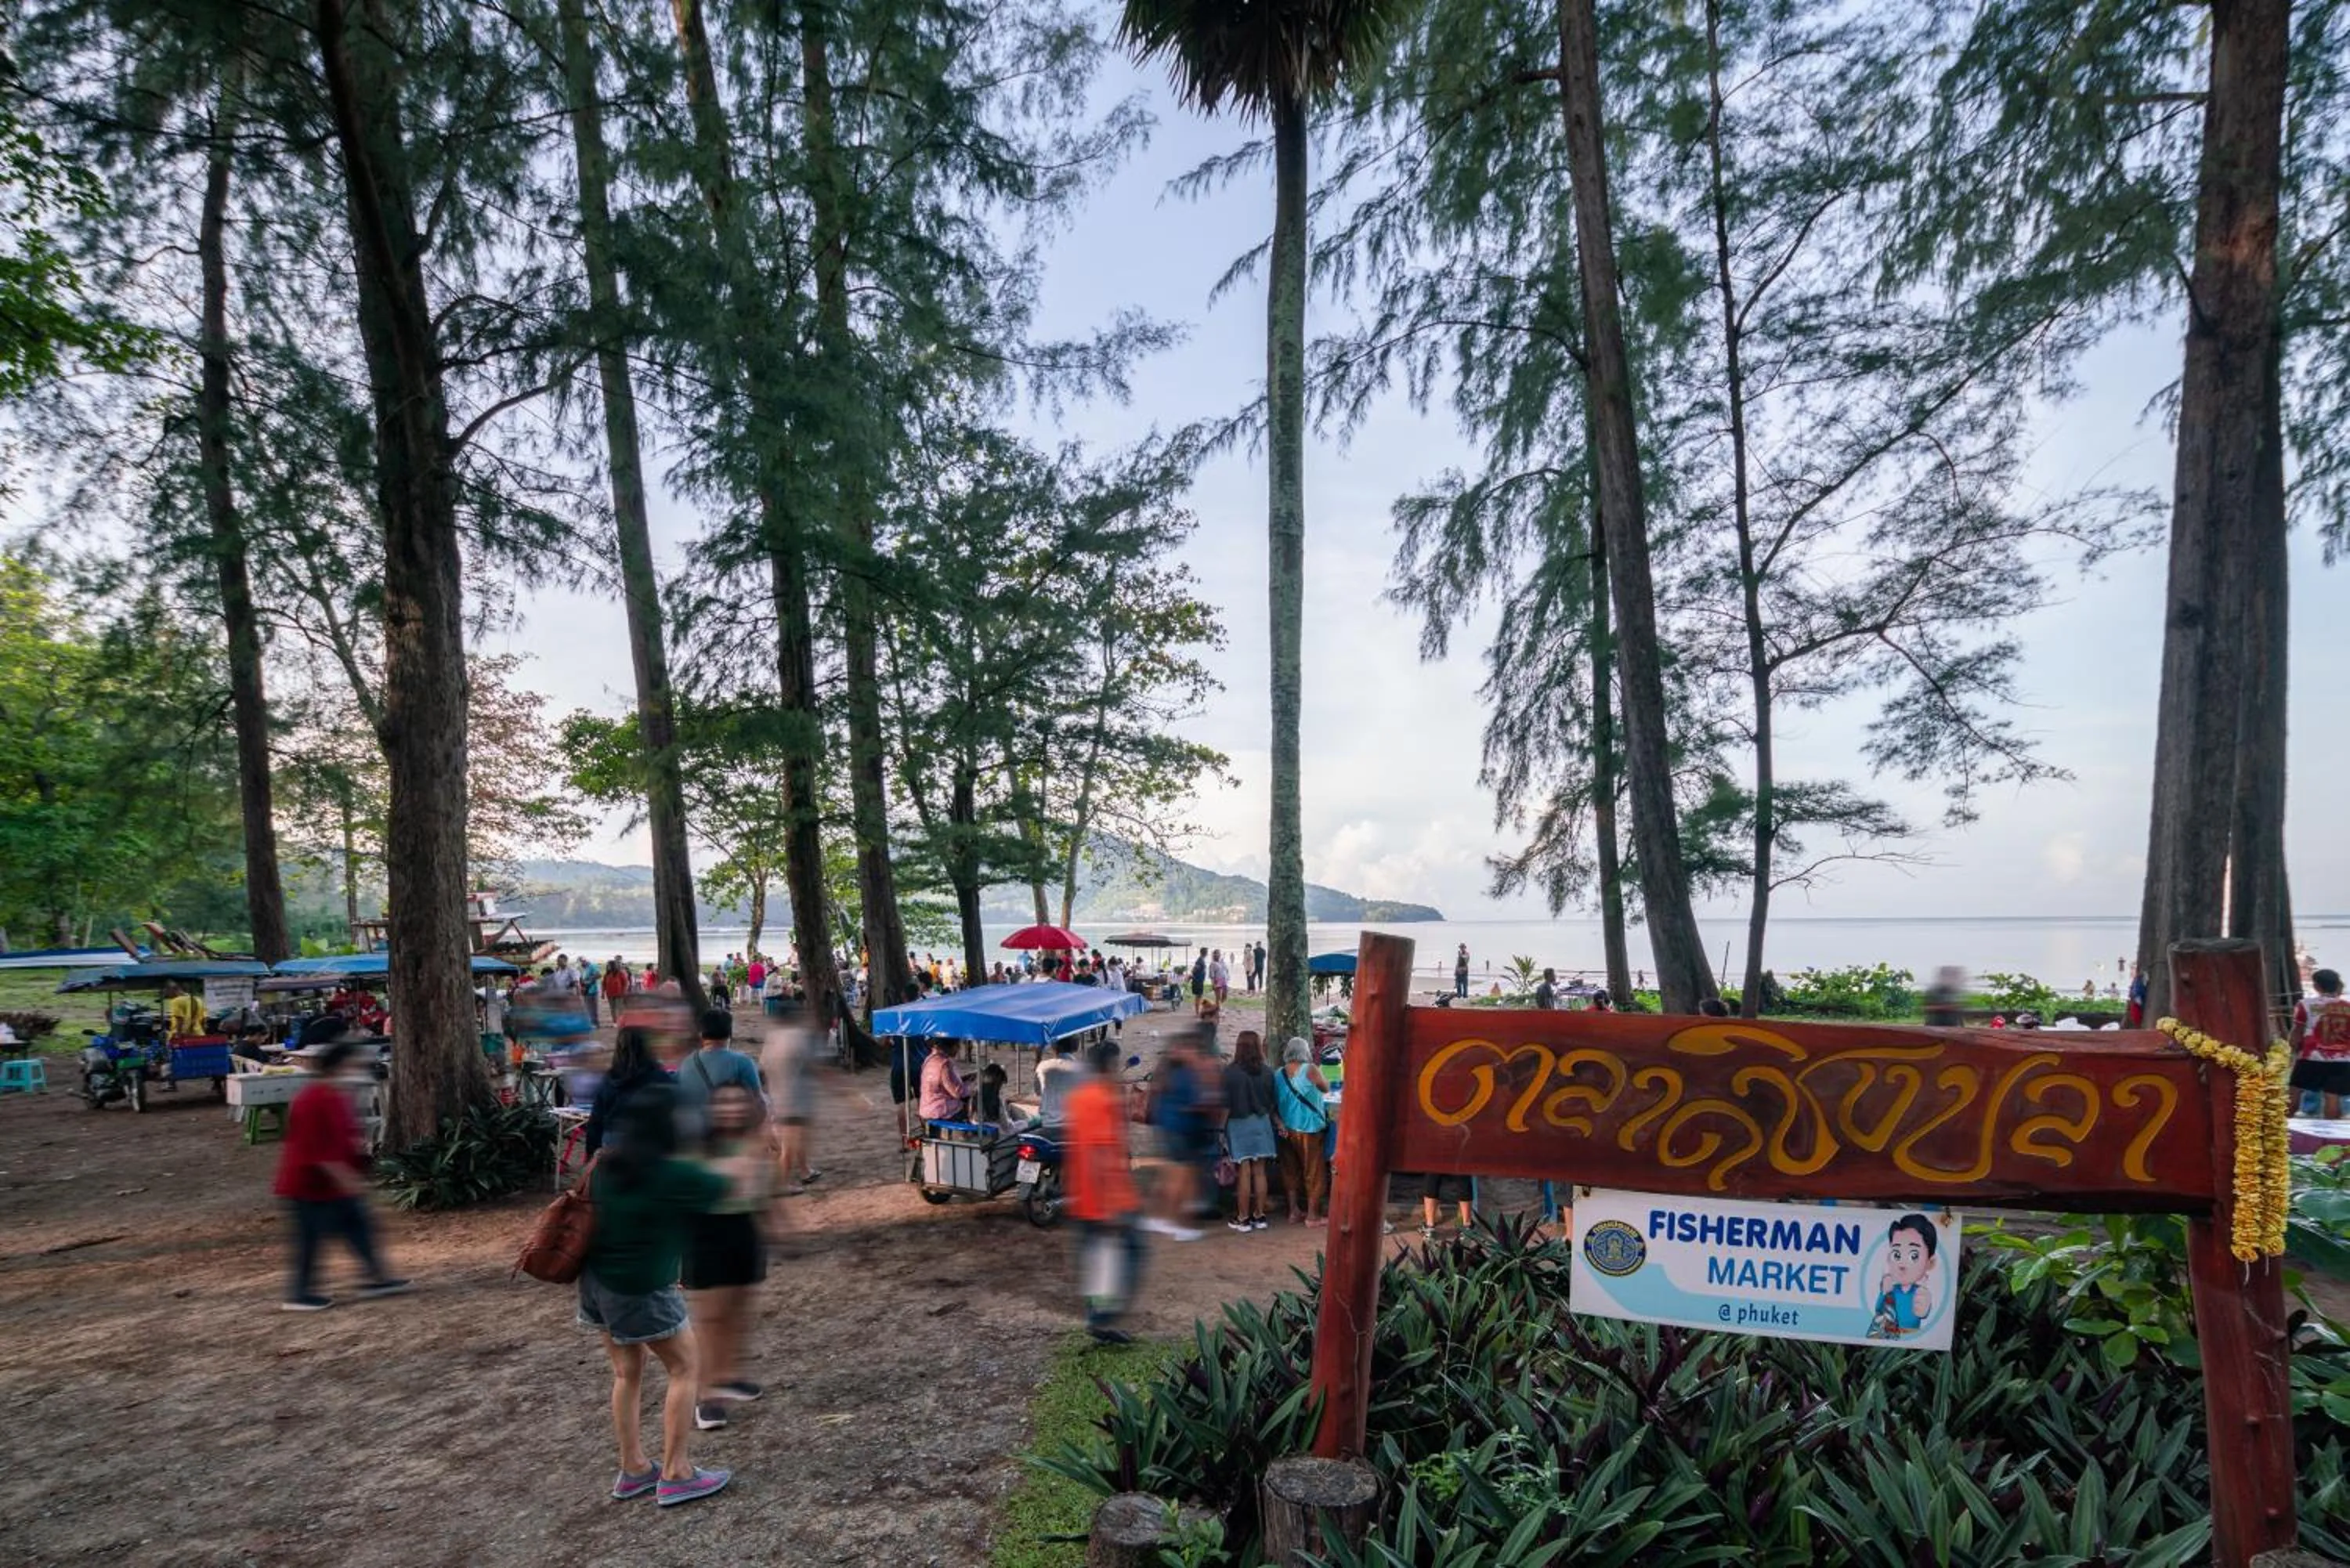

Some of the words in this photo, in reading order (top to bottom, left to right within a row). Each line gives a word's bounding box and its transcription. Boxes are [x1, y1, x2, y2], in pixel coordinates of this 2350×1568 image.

[1649, 1210, 1860, 1255] FISHERMAN
[1708, 1257, 1849, 1295] MARKET
[1737, 1302, 1800, 1325] phuket
